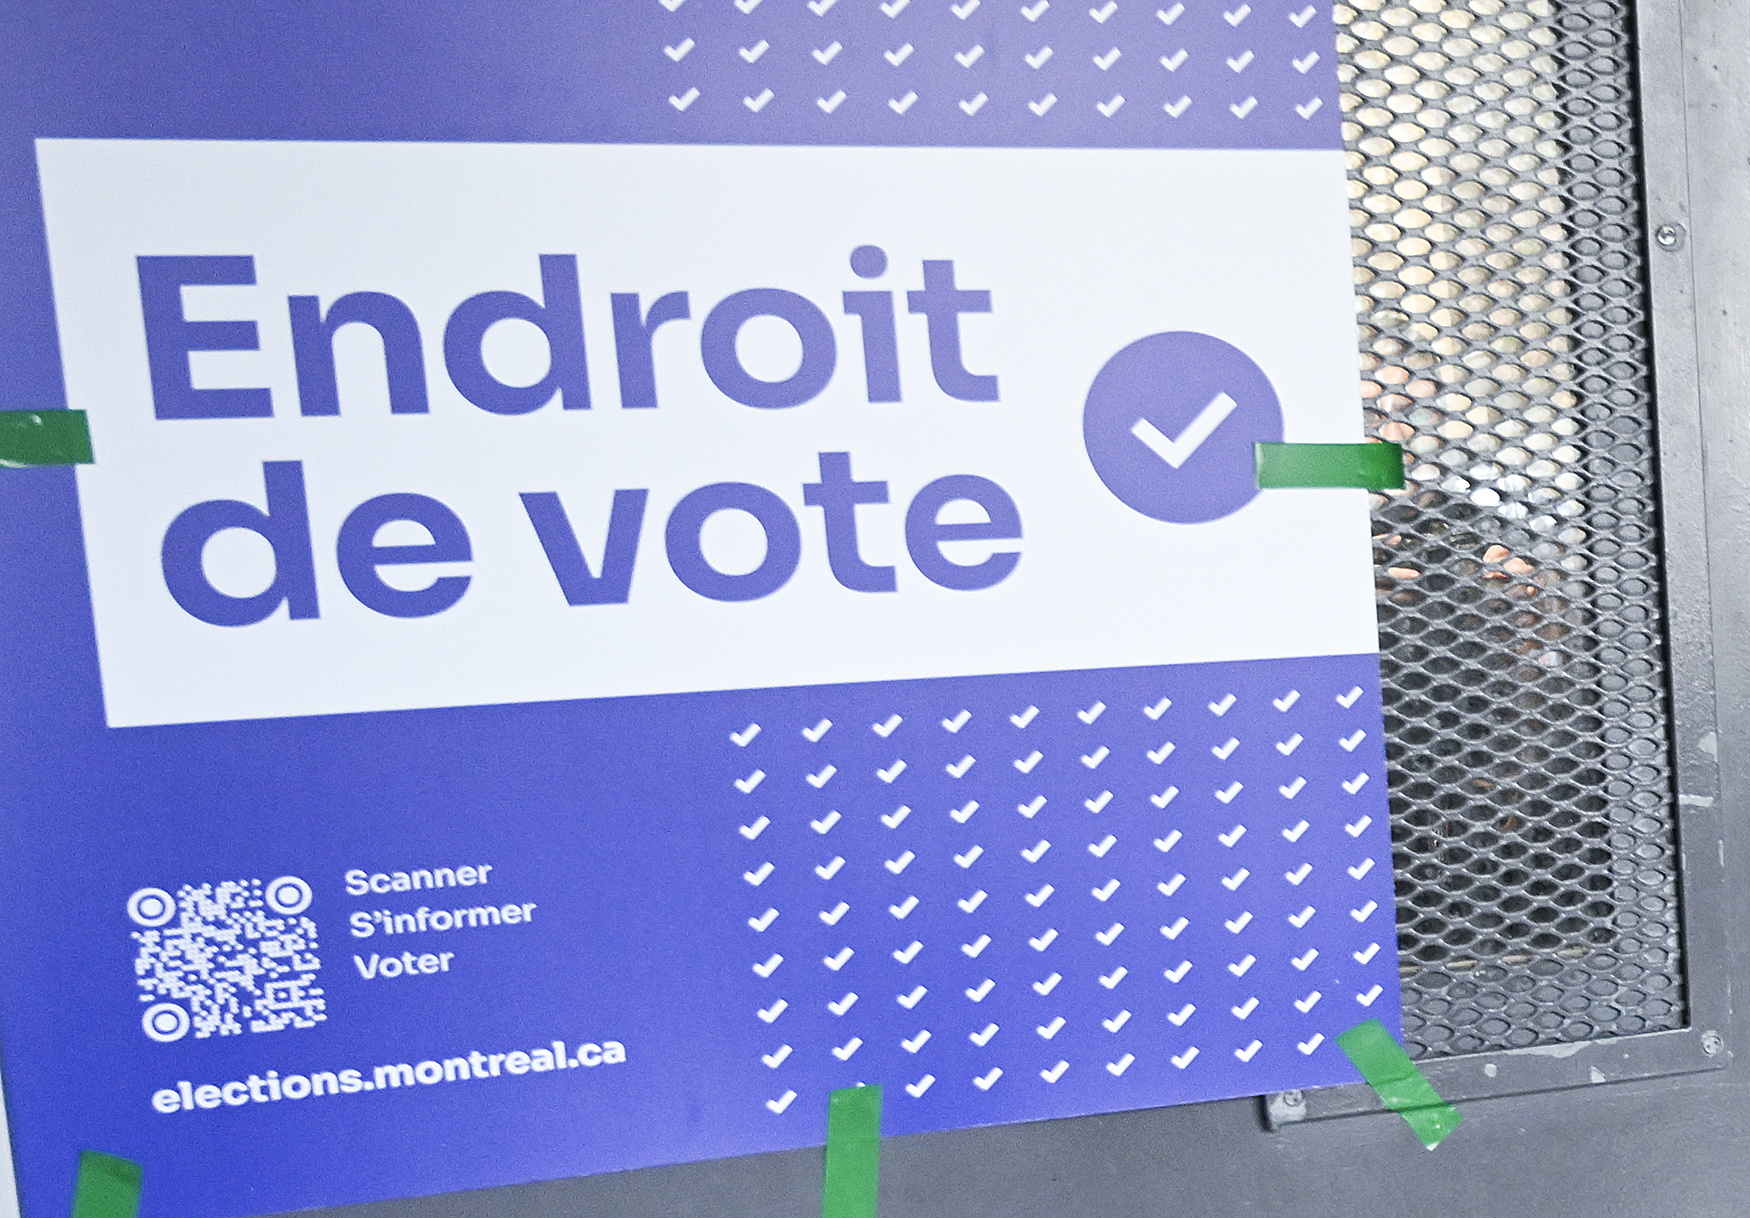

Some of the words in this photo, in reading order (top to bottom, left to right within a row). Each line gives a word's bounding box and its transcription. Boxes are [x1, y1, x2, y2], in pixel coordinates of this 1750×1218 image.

[135, 246, 998, 420] Endroit
[161, 460, 472, 627] de
[519, 452, 1022, 606] vote
[345, 864, 492, 895] Scanner
[350, 902, 536, 938] S'informer
[354, 951, 454, 979] Voter
[151, 1038, 627, 1113] elections.montreal.ca
